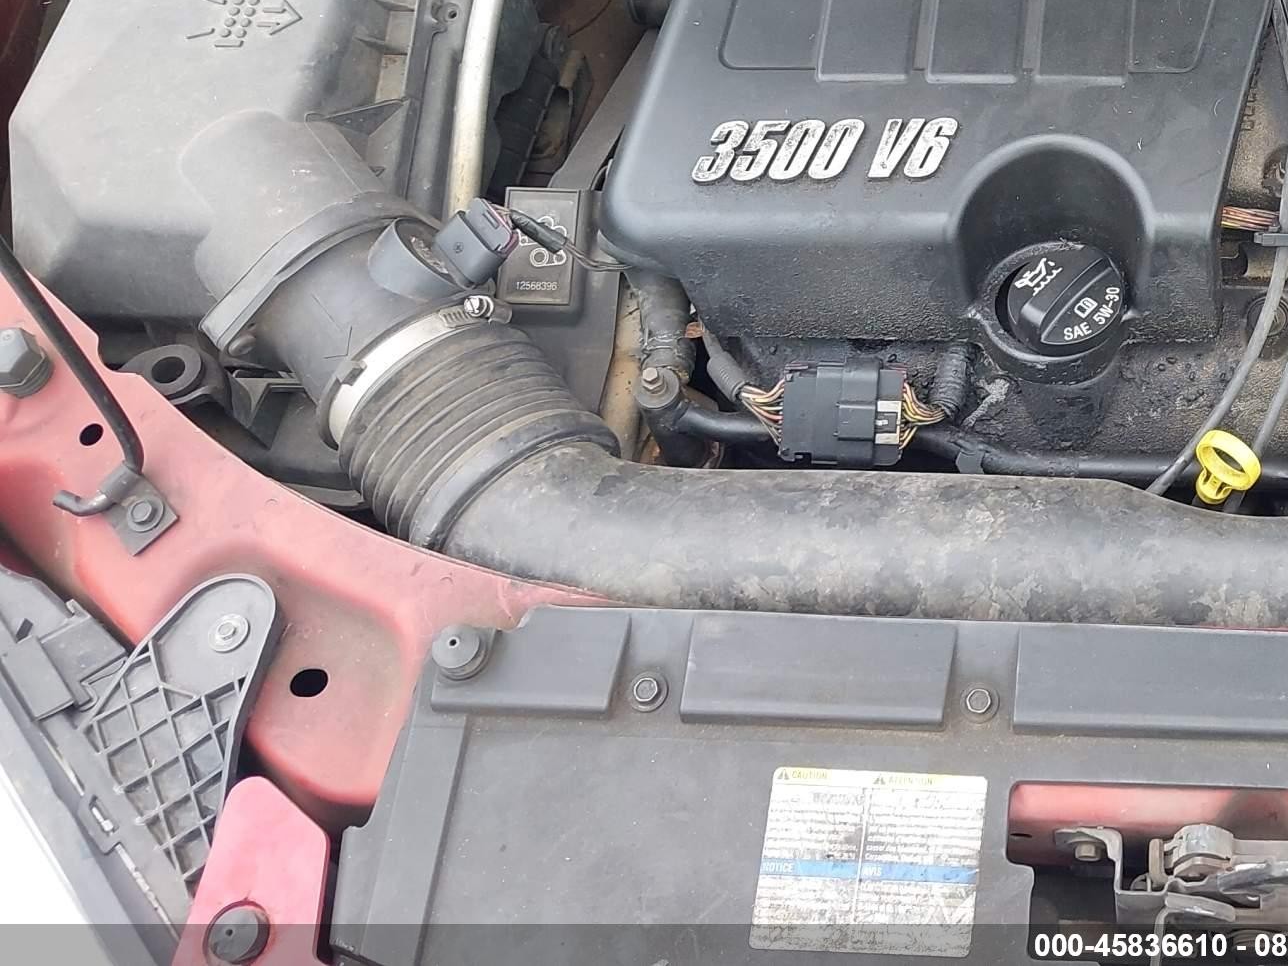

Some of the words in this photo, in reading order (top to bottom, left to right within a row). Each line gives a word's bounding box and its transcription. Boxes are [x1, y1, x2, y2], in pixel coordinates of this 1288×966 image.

[691, 118, 865, 183] 3500
[867, 116, 960, 179] V6
[1064, 322, 1092, 342] SAE
[1092, 286, 1120, 325] 5W-30
